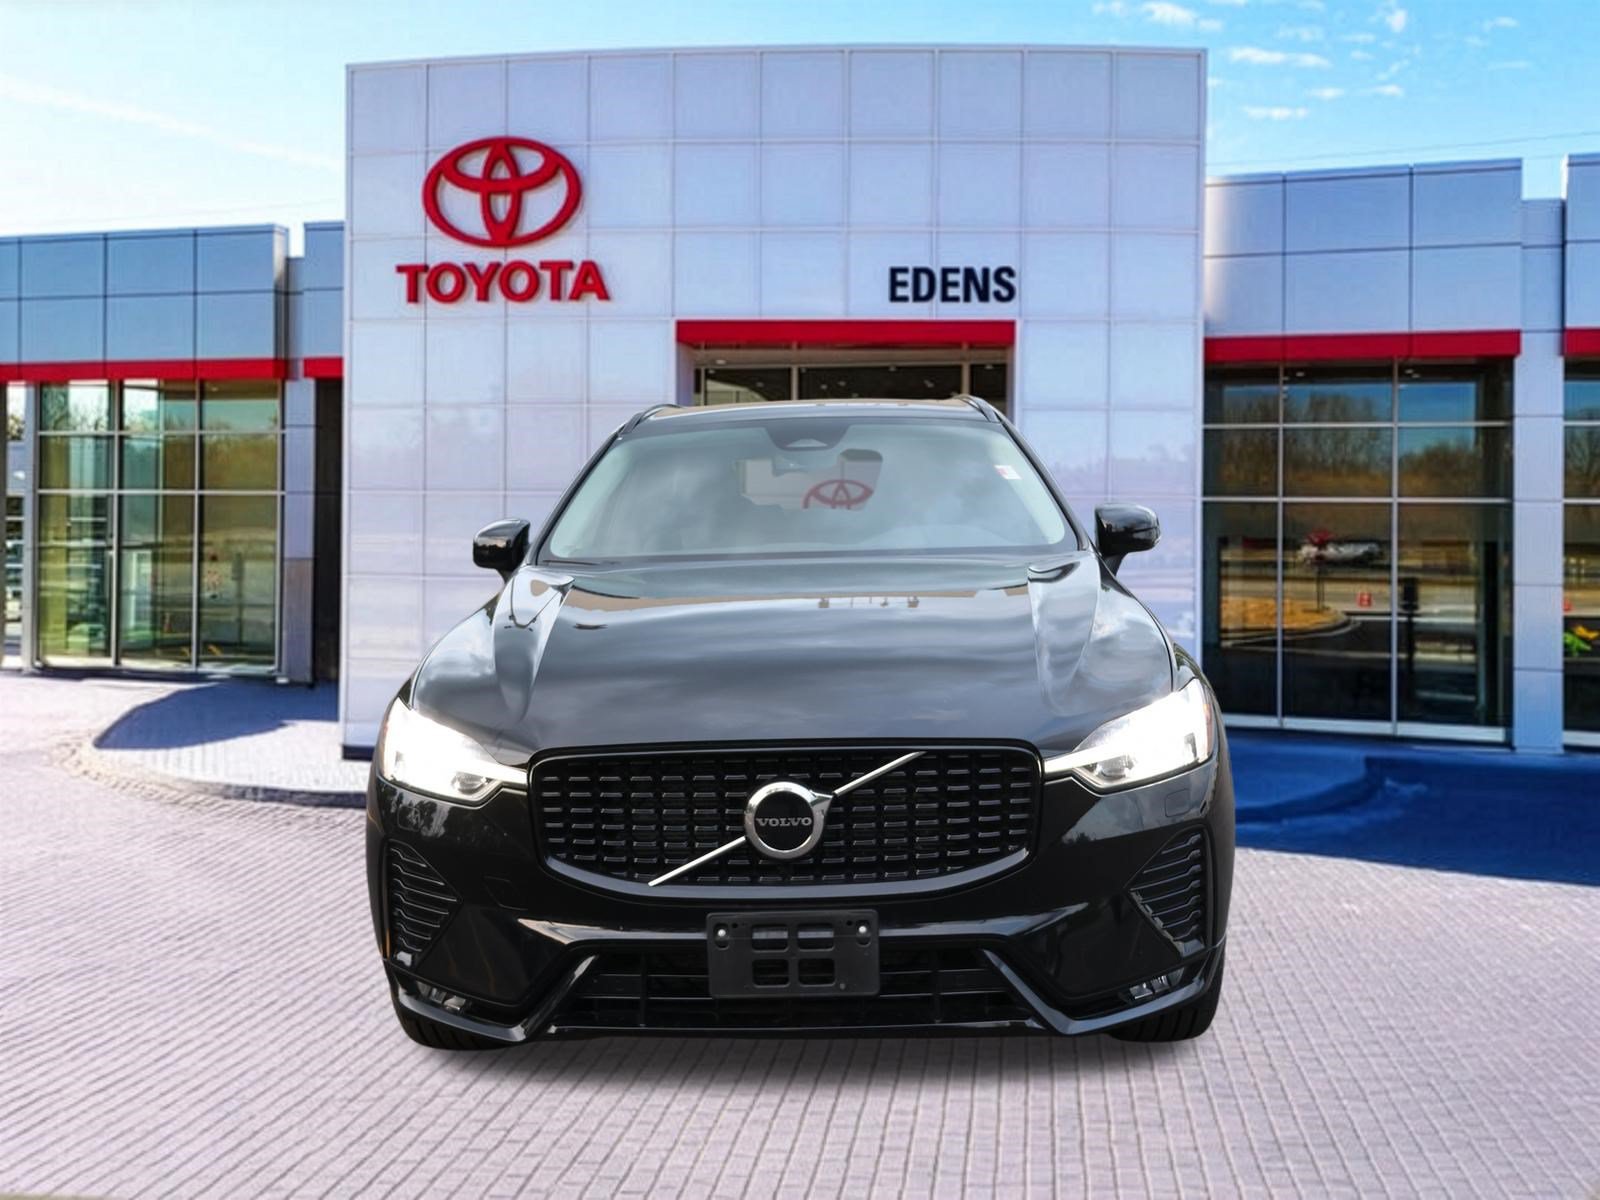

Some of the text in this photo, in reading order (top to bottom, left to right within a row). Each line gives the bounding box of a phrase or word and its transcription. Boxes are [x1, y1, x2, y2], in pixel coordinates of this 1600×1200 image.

[396, 260, 610, 304] TOYOTA
[889, 266, 1017, 302] EDENS
[755, 816, 813, 827] VOLVO
